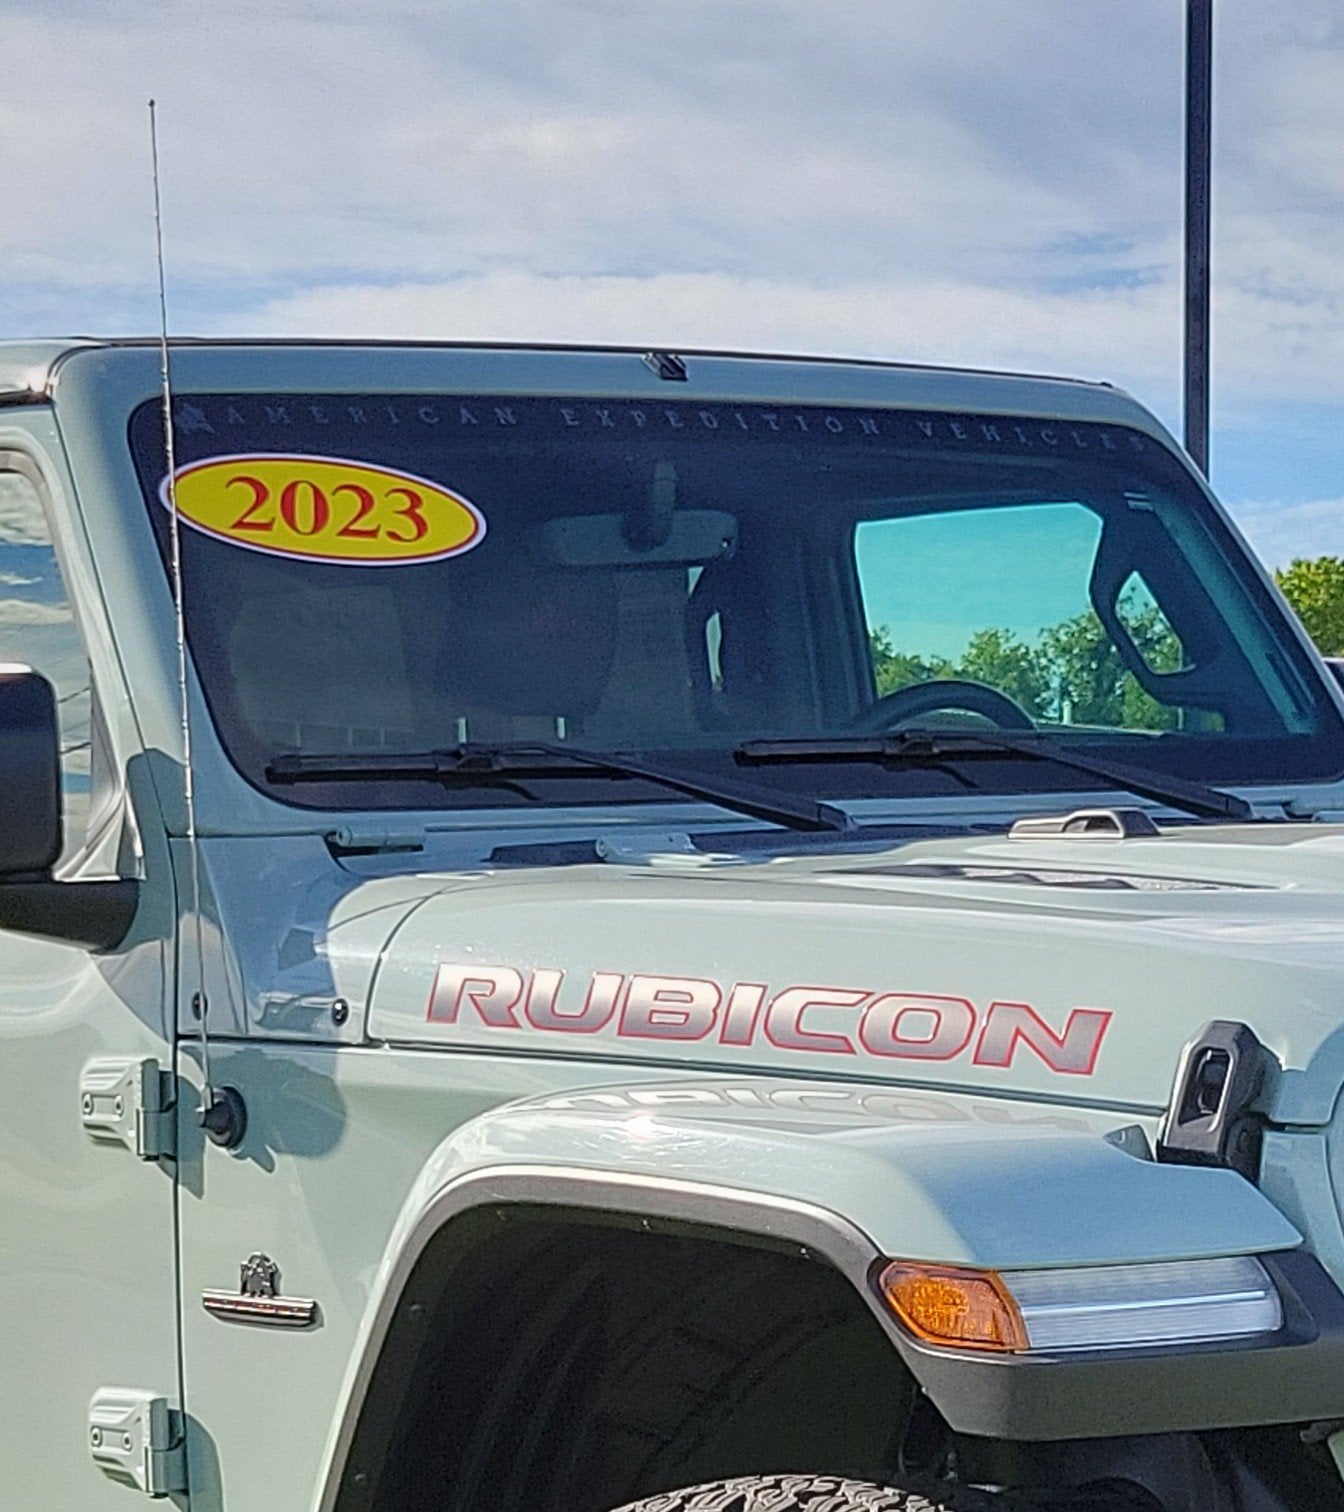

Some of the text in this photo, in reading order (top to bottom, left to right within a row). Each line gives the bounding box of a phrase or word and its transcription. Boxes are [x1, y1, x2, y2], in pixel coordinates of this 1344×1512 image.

[226, 405, 1147, 453] AMERICAN EXPEDITION VEHICLES
[224, 475, 429, 543] 2023
[425, 962, 1114, 1077] RUBICON
